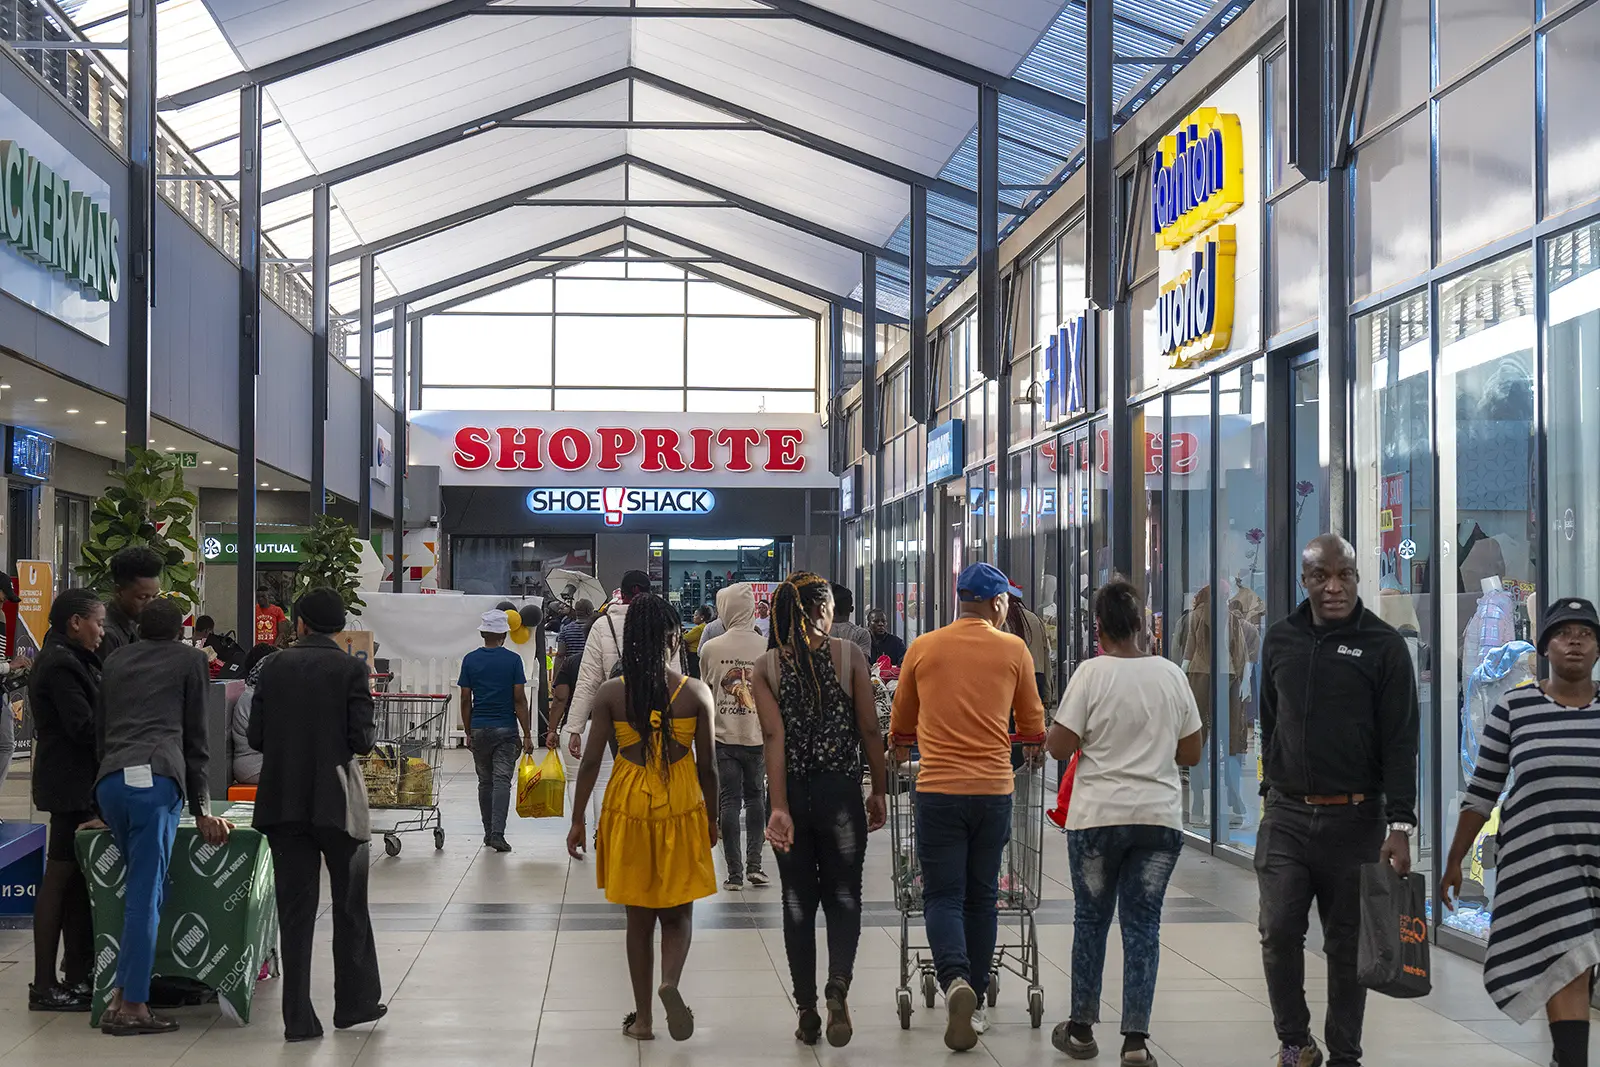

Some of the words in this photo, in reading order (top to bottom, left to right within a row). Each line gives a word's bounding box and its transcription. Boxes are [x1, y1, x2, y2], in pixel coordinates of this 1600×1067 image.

[1157, 241, 1216, 357] world
[1041, 316, 1085, 422] FIX
[452, 426, 806, 472] SHOPRITE
[532, 490, 601, 512] SHOE
[626, 490, 709, 512] SHACK
[176, 924, 205, 957] AVBOB
